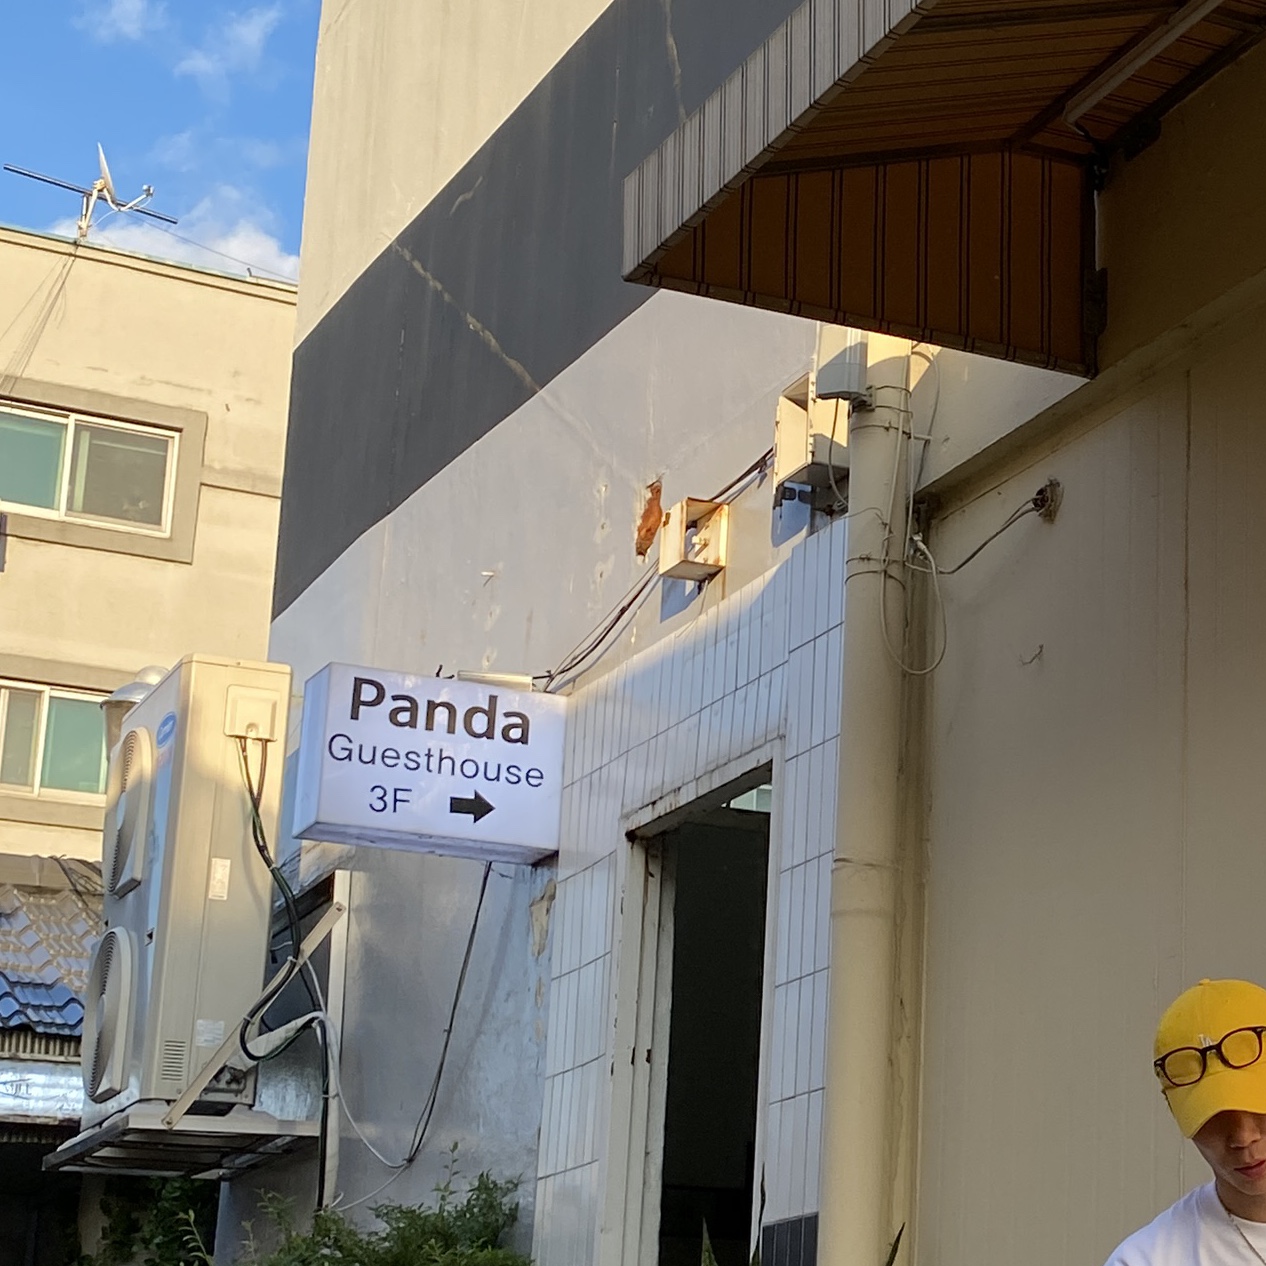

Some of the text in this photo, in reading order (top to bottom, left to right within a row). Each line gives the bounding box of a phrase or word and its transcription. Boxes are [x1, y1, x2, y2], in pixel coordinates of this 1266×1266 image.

[350, 676, 530, 745] Panda
[328, 733, 544, 788] Guesthouse
[369, 785, 412, 813] 3F
